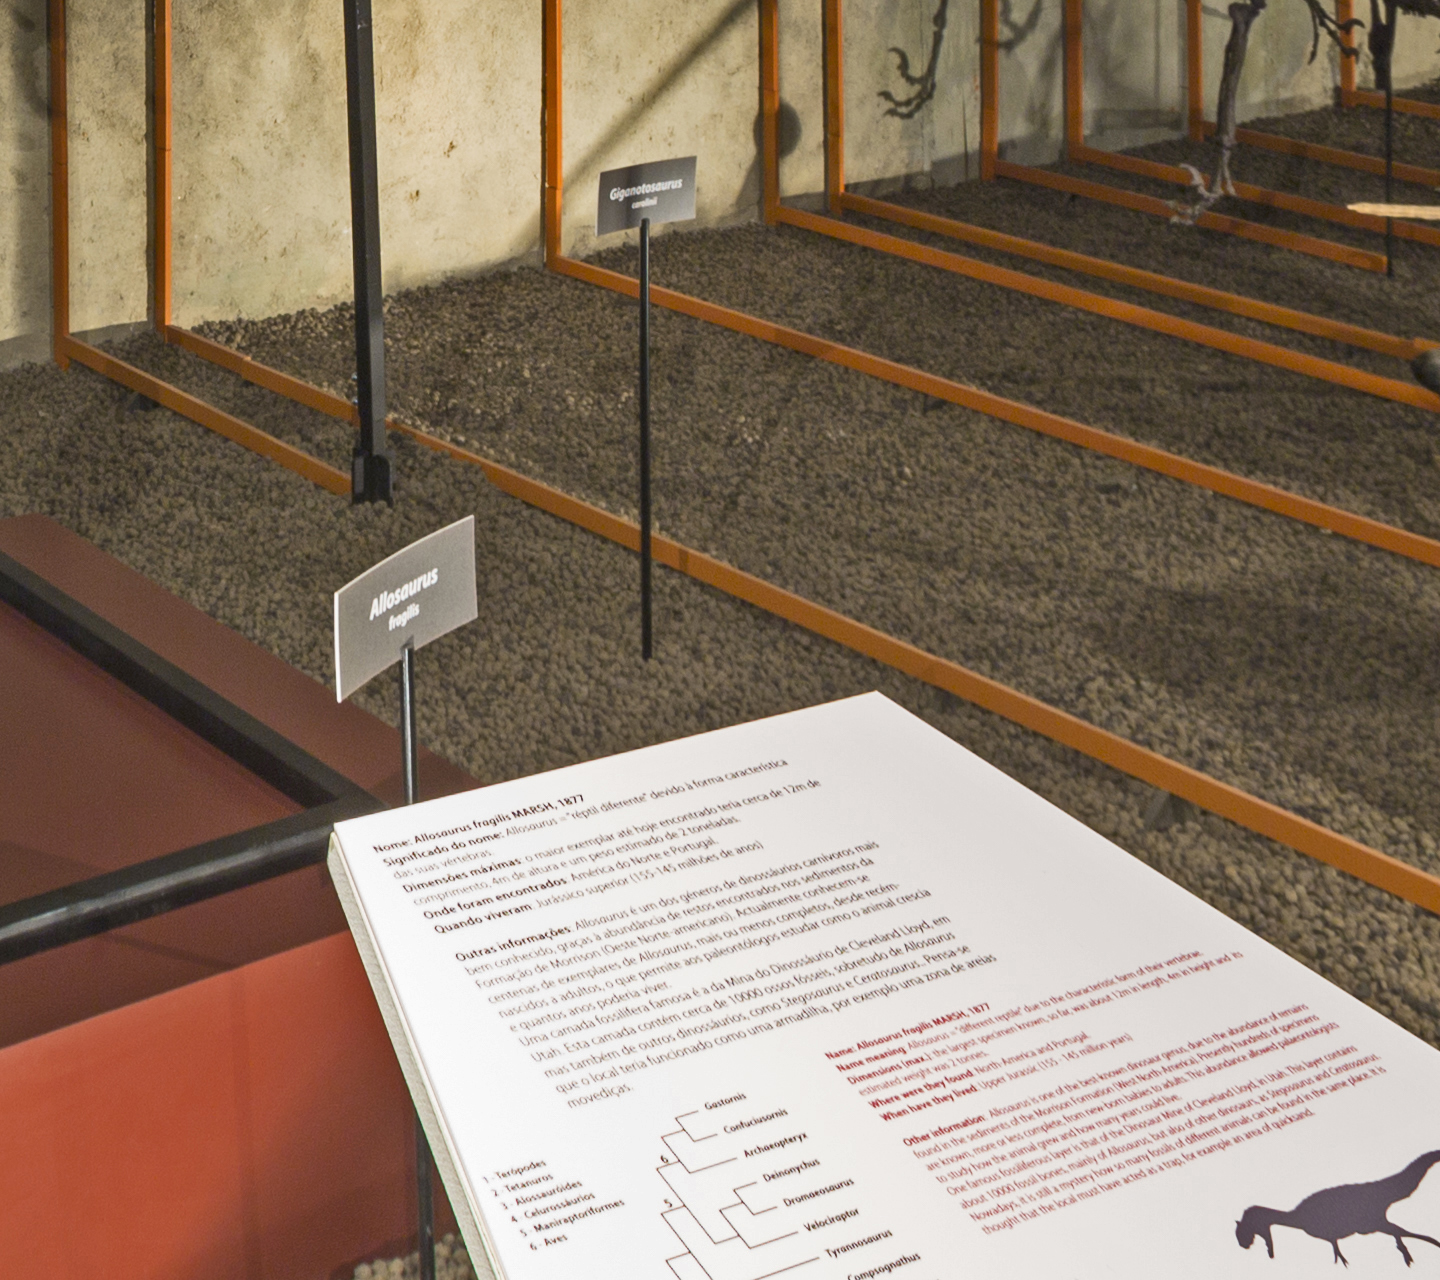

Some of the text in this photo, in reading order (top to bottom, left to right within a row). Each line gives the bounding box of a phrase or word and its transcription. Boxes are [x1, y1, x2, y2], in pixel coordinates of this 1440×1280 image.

[609, 178, 683, 202] Giganotosaurus
[369, 567, 440, 621] Allosaurus
[388, 602, 421, 631] fragilis
[382, 845, 450, 867] Significado
[505, 817, 559, 837] Allosaurus
[649, 785, 686, 800] devido
[691, 775, 725, 789] forma
[724, 759, 789, 781] característica
[414, 824, 473, 844] Allosaurus
[472, 813, 512, 829] fragilis
[557, 793, 584, 807] 1877
[402, 871, 469, 894] Dimensões
[533, 846, 566, 861] maior
[566, 833, 616, 852] exemplar
[617, 827, 635, 839] até
[631, 822, 659, 834] hoje
[658, 806, 718, 828] encontrado
[716, 800, 743, 813] teria
[741, 793, 770, 806] cerca
[782, 783, 808, 795] 12m
[423, 905, 457, 920] Onde
[456, 897, 495, 912] foram
[570, 865, 616, 882] América
[629, 852, 663, 866] Norte
[433, 915, 483, 934] Quando
[535, 889, 585, 909] Jurássico
[584, 877, 630, 895] superior
[677, 853, 720, 870] milhões
[734, 840, 765, 855] anos)
[704, 1092, 747, 1111] Gastornis
[723, 1108, 789, 1134] Confuciusornis
[743, 1132, 808, 1159] Archaeopteryx
[762, 1158, 821, 1183] Deinonychus
[782, 1178, 855, 1208] Dromaeosaurus
[803, 1208, 860, 1232] Velociraptor
[824, 1229, 894, 1259] Tyrannosaurus
